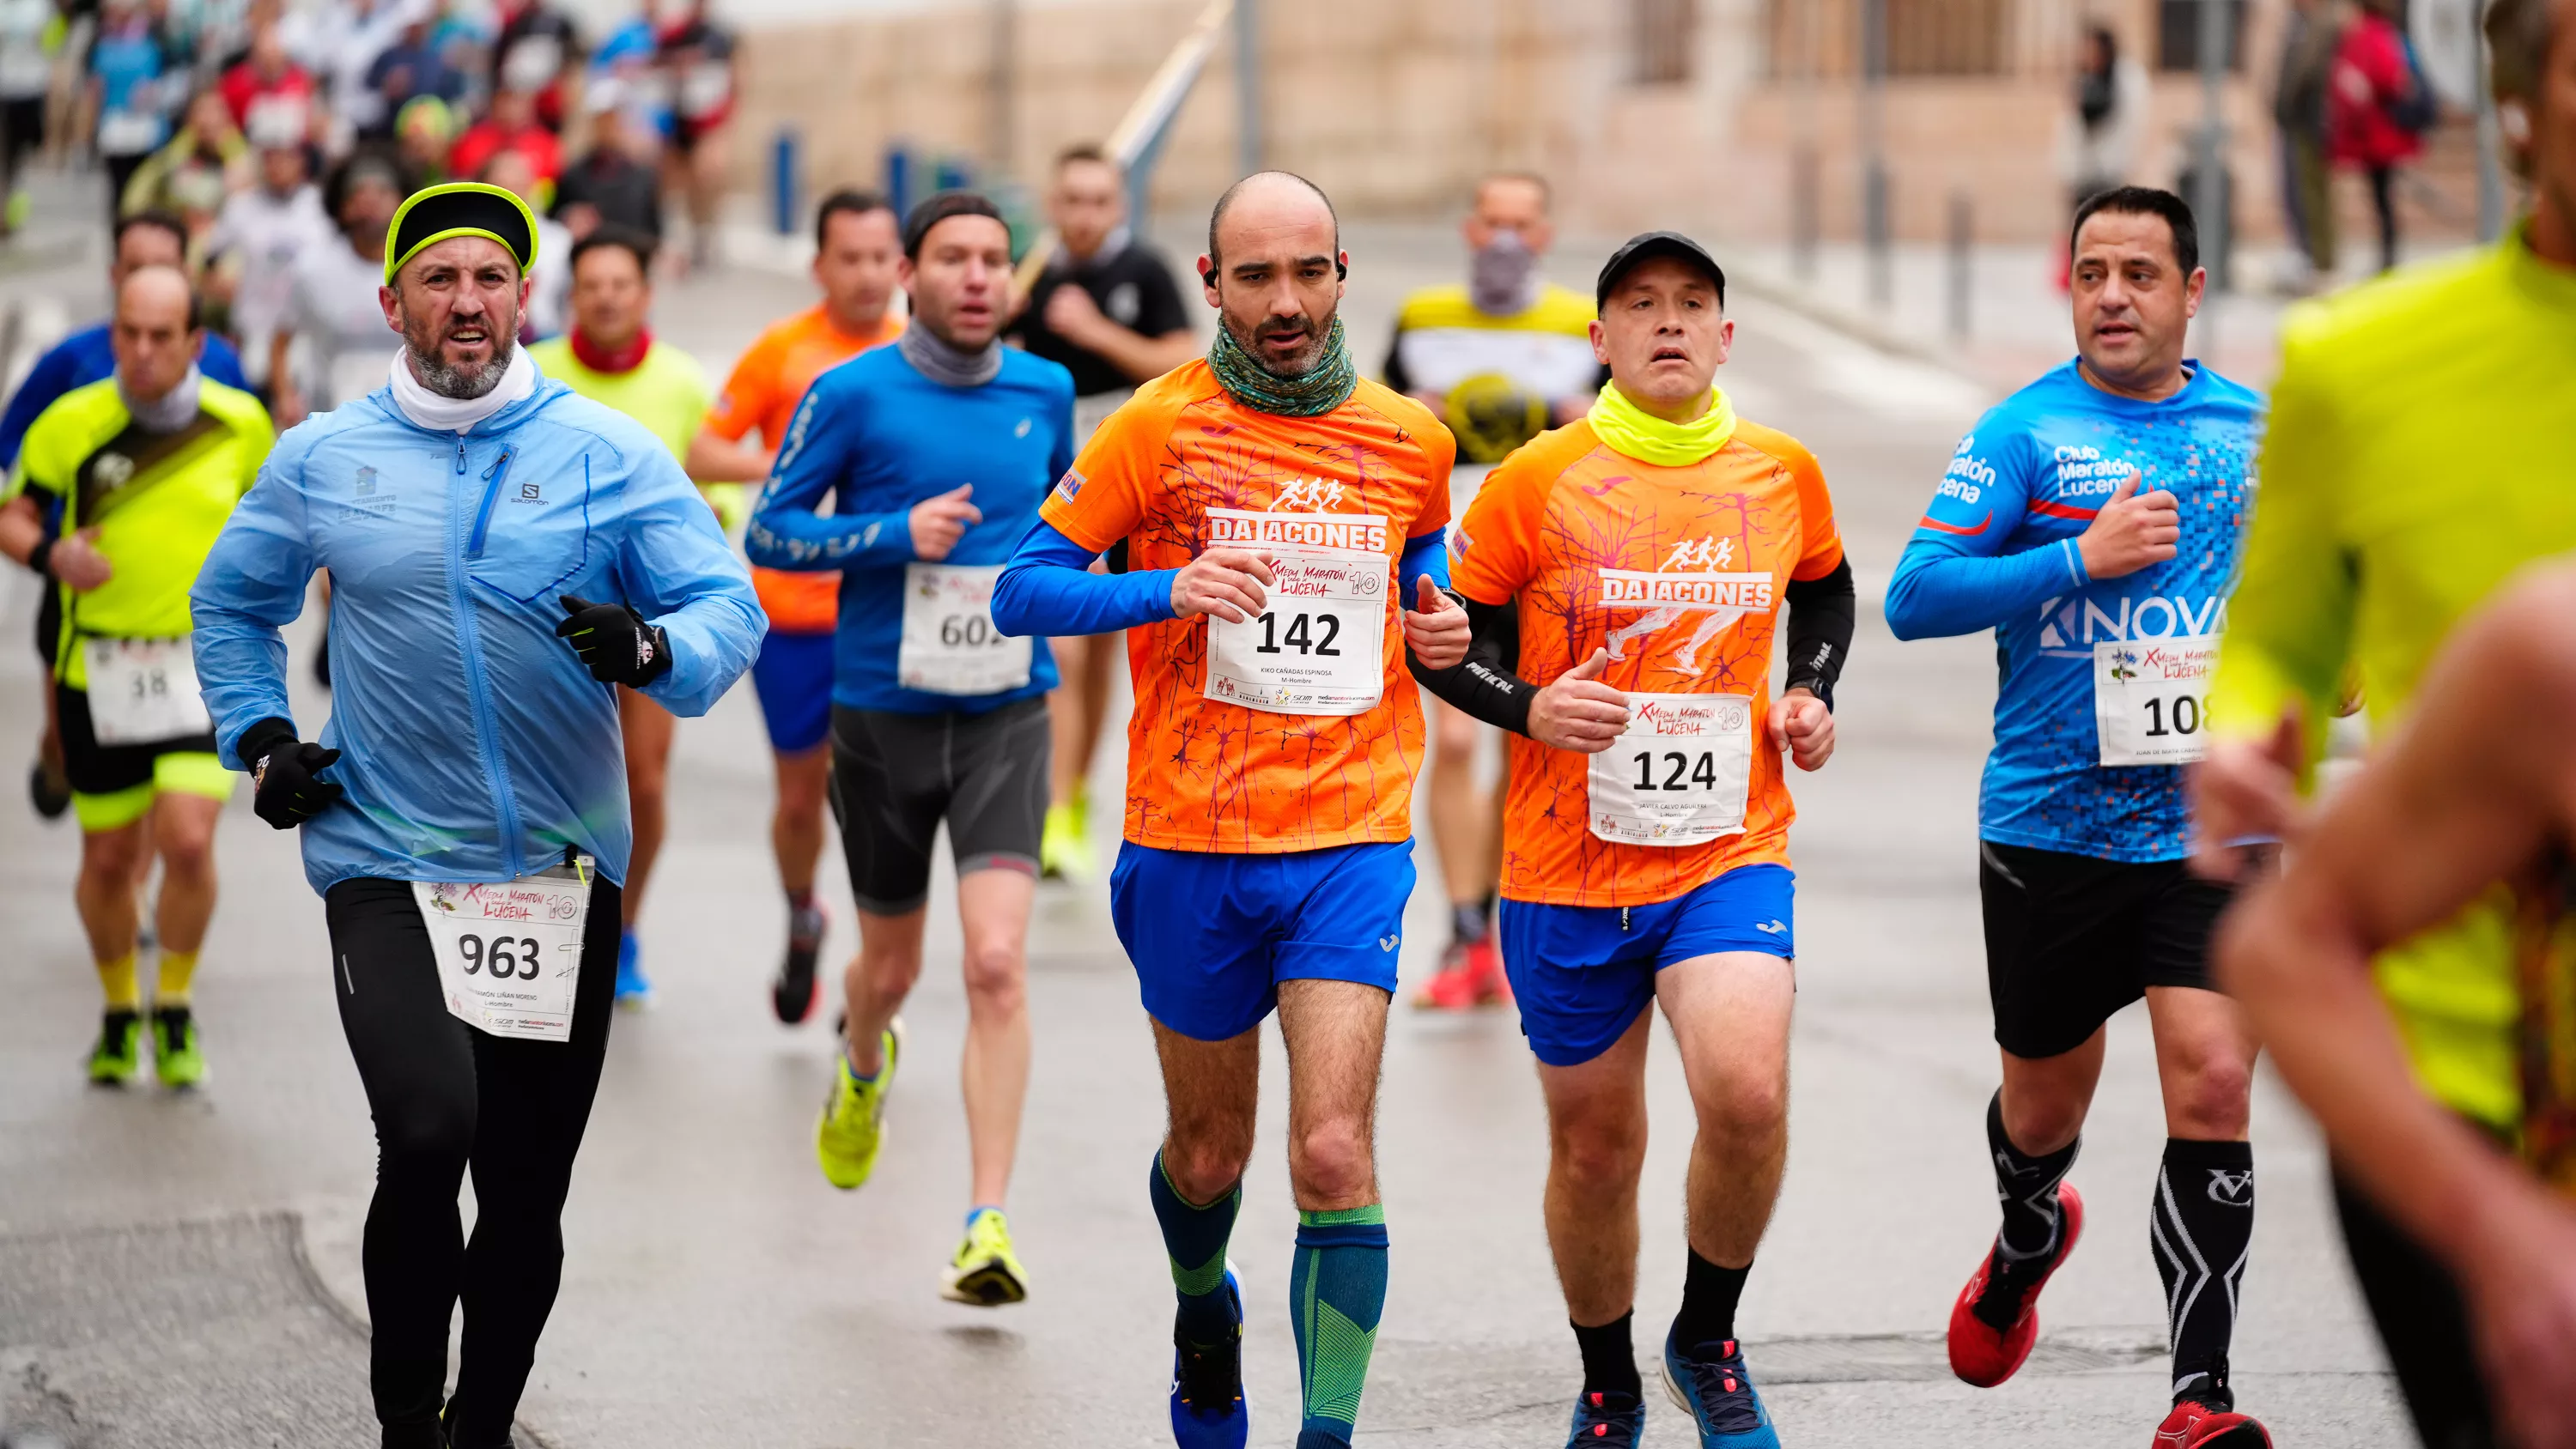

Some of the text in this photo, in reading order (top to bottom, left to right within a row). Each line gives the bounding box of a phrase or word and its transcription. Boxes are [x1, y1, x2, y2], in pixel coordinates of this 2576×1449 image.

[2054, 445, 2099, 463] Club
[1946, 454, 1996, 488] ratón
[2057, 458, 2136, 481] Maratón
[1936, 477, 1981, 505] cena
[1211, 515, 1388, 552] DATACONES
[1280, 579, 1334, 597] LUCENA
[1603, 578, 1773, 608] DATACONES
[941, 614, 1005, 649] 60
[1256, 611, 1340, 657] 142
[2143, 646, 2160, 670] X
[1276, 667, 1304, 676] CAÑADAS
[1637, 701, 1655, 724] X
[1656, 720, 1707, 736] LUCENA
[1633, 751, 1716, 791] 124
[464, 882, 483, 905] X
[483, 901, 533, 922] LUCENA
[459, 933, 540, 980] 963
